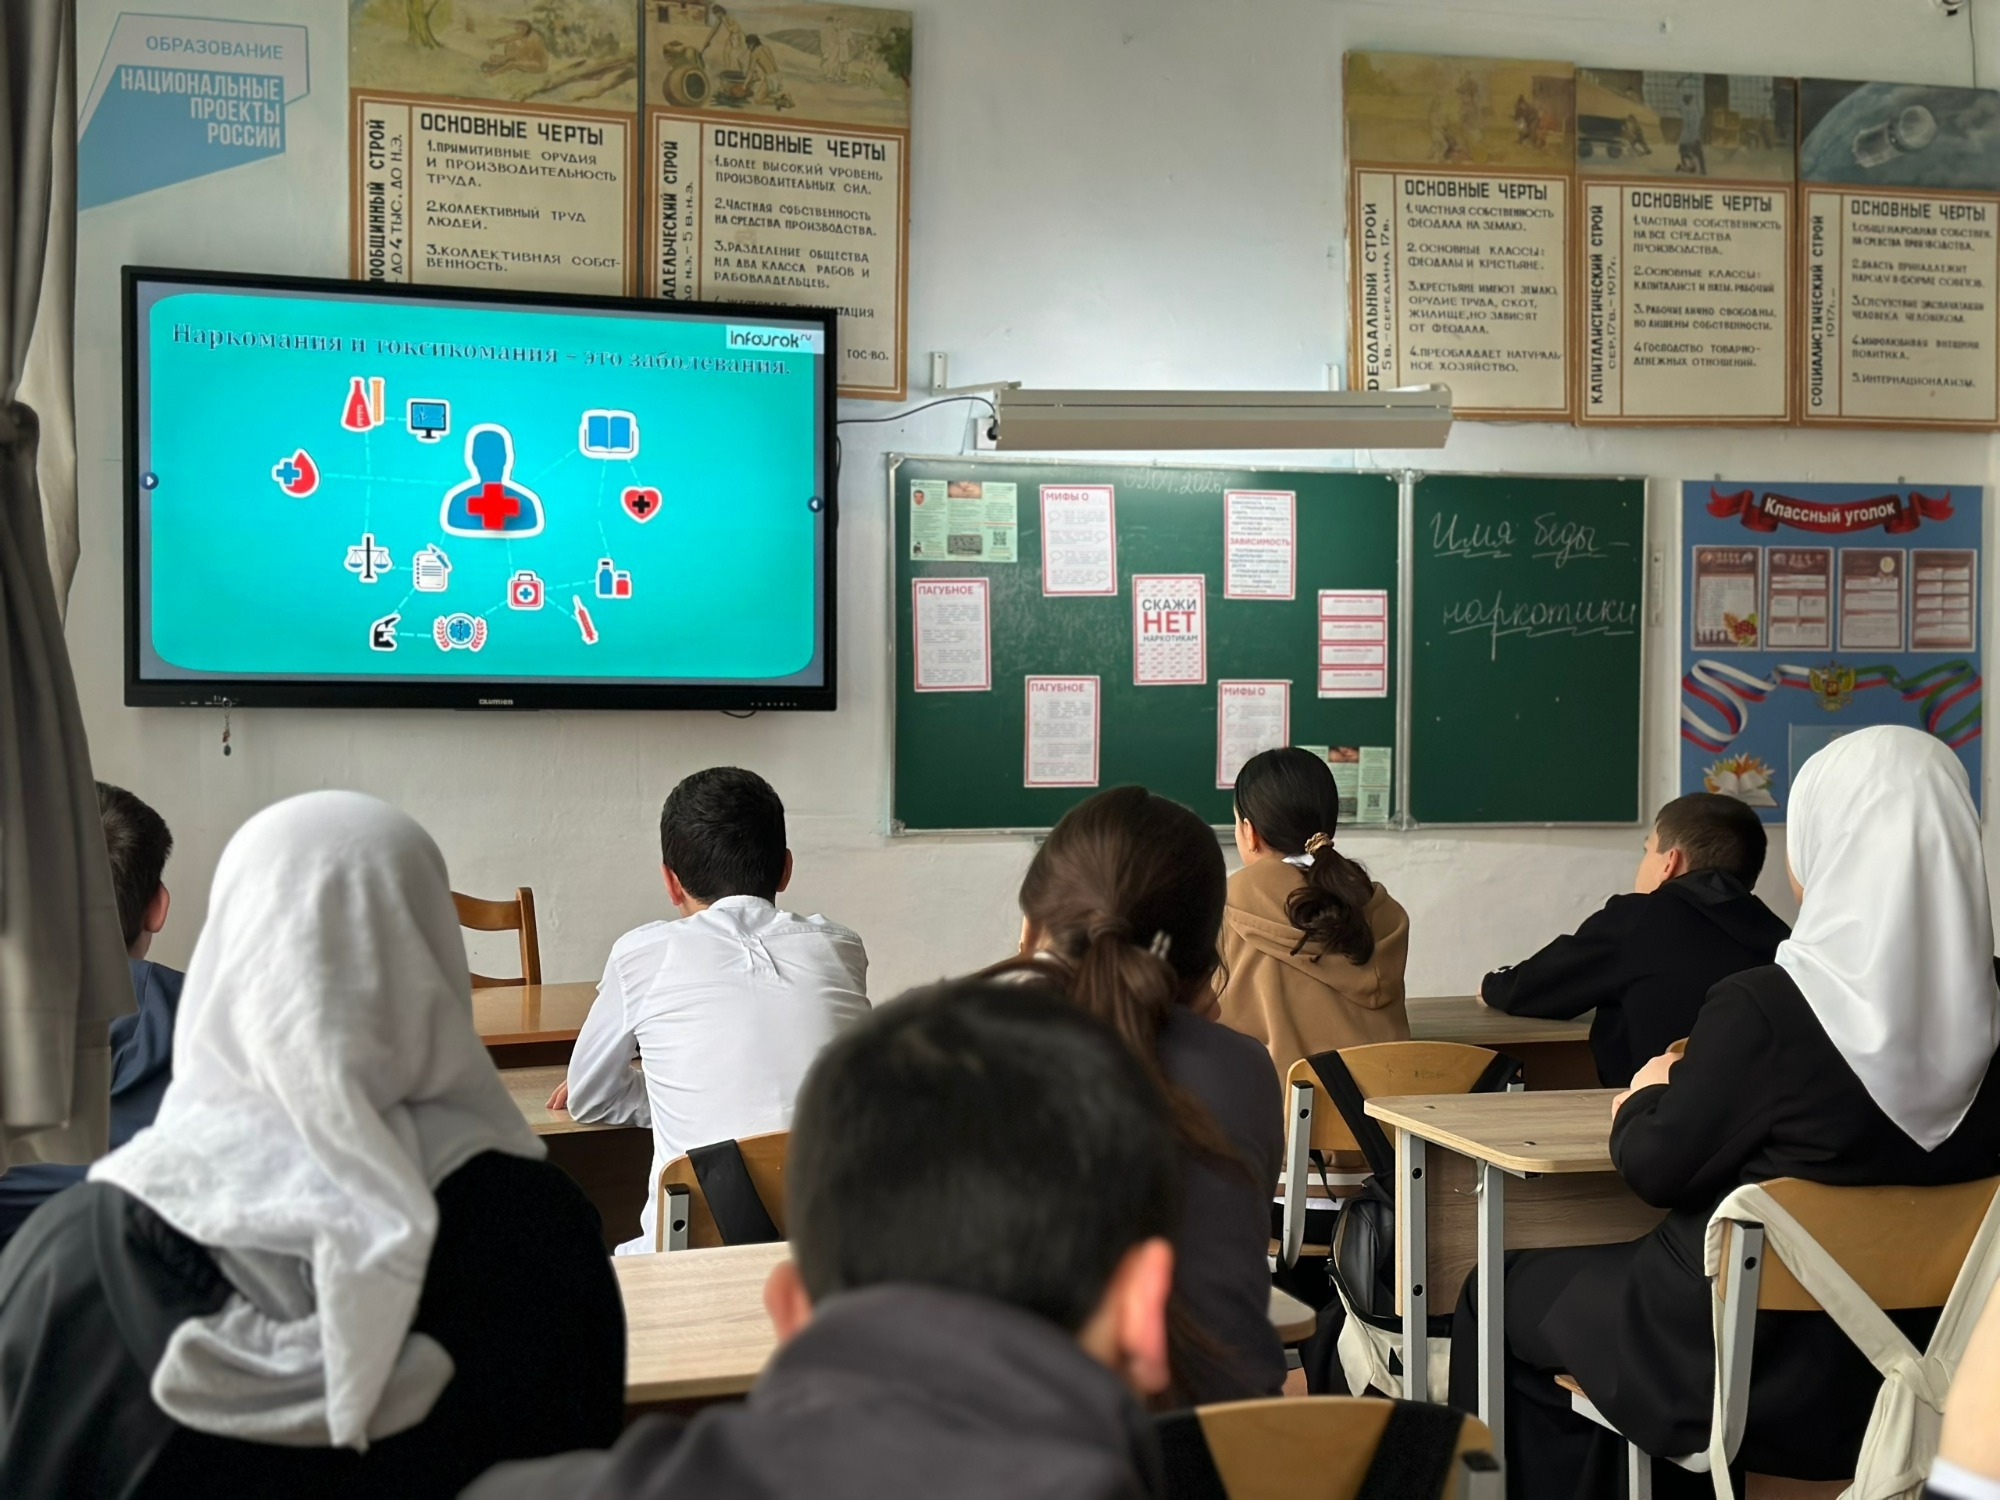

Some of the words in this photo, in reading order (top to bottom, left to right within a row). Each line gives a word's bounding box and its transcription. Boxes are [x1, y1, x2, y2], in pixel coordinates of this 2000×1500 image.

[146, 35, 284, 60] ОБРАЗОВАНИЕ
[121, 68, 280, 100] НАЦИОНАЛЬНЫЕ
[191, 97, 280, 125] ПРОЕКТЫ
[208, 122, 281, 148] РОССИИ
[421, 113, 528, 139] ОСНОВНЫЕ
[538, 122, 604, 146] ЧЕРТЫ
[366, 119, 385, 170] СТРОЙ
[715, 129, 813, 155] ОСНОВНЫЕ
[827, 139, 886, 161] ЧЕРТЫ
[541, 151, 597, 165] ОРУДИЯ
[660, 140, 678, 184] СТРОЙ
[427, 157, 437, 169] И
[446, 158, 617, 182] ПРОИЗВОДИТЕЛЬНОСТЬ
[763, 161, 823, 177] ВЫСОКИЙ
[829, 167, 883, 182] УРОВЕНЬ
[427, 172, 482, 187] ТРУДА.
[716, 172, 836, 192] ПРОИЗВОДИТЕЛЬНЫХ
[843, 182, 871, 195] СИЛ.
[1404, 179, 1490, 199] ОСНОВНЫЕ
[1498, 183, 1547, 201] ЧЕРТЫ
[1631, 191, 1713, 211] ОСНОВНЫЕ
[1723, 194, 1772, 213] ЧЕРТЫ
[551, 210, 586, 223] ТРУД
[779, 205, 871, 222] СОБСТВЕННОСТЬ
[1468, 206, 1555, 219] СОБСТВЕННОСТЬ
[1851, 199, 1931, 219] ОСНОВНЫЕ
[1940, 205, 1985, 222] ЧЕРТЫ
[427, 216, 488, 231] ЛЮДЕЙ.
[715, 214, 728, 225] НА
[730, 215, 781, 230] СРЕДСТВА
[785, 220, 878, 237] ПРОИЗВОДСТВА.
[1407, 217, 1462, 230] ФЕОДАЛА
[1466, 219, 1480, 230] НА
[1483, 220, 1527, 232] ЗЕМЛЮ.
[1590, 205, 1604, 247] СТРОЙ
[1693, 219, 1782, 230] СОБСТВЕННОСТЬ
[1361, 203, 1377, 263] СТРОЙ
[1633, 230, 1646, 240] НА
[1648, 230, 1665, 240] ВСЕ
[1670, 230, 1732, 242] СРЕДСТВА
[1810, 215, 1824, 257] СТРОЙ
[660, 193, 678, 300] АДЕЛЬЧЕСКИЙ
[1489, 246, 1545, 258] КЛАССЫ:
[1633, 243, 1724, 255] ПРОИЗВОДСТВА.
[572, 255, 621, 268] СОБСТ-
[809, 248, 869, 264] ОБЩЕСТВА
[1408, 256, 1463, 269] ФЕОДАЛЫ
[1466, 258, 1475, 269] И
[1479, 259, 1545, 271] КРЕСТЬЯНЕ.
[427, 257, 508, 272] ВЕННОСТЬ.
[715, 256, 729, 267] НА
[735, 258, 757, 269] ДВА
[762, 260, 806, 274] КЛАССА
[816, 263, 856, 278] РАБОВ
[861, 266, 871, 278] И
[715, 271, 829, 289] РАБОВЛАДЕЛЬЦЕВ.
[1634, 281, 1697, 292] КАПИТАЛИСТ
[1699, 283, 1705, 292] И
[1478, 283, 1516, 295] ИМЕЮТ
[1408, 295, 1458, 307] ОРУДИЕ
[1460, 296, 1499, 309] ТРУДА,
[1502, 298, 1538, 310] СКОТ,
[1489, 310, 1538, 322] ЗАВИСЯТ
[1852, 310, 1900, 321] ЧЕЛОВЕКА
[1408, 323, 1425, 334] ОТ
[1431, 323, 1490, 336] ФЕОДАЛА.
[1590, 253, 1604, 404] КАПИТАЛИСТИЧЕСКИЙ
[1634, 319, 1646, 329] НО
[1648, 320, 1690, 330] ЛИШЕНЫ
[1811, 264, 1824, 407] СОЦИАЛИСТИЧЕСКИЙ
[172, 323, 343, 351] Наркомания
[350, 336, 366, 352] и
[377, 339, 558, 363] токсикомания
[585, 347, 623, 368] это
[629, 351, 791, 376] заболевания.
[1410, 361, 1434, 372] НОЕ
[1439, 361, 1519, 374] ХОЗЯЙСТВО.
[1633, 356, 1688, 367] ДЕНЕЖНЫХ
[1046, 492, 1079, 501] МИФЫ
[1763, 496, 1841, 524] Классный
[1846, 502, 1897, 527] уголок
[1430, 512, 1517, 550] Имя
[1533, 512, 1601, 570] беды
[918, 585, 974, 595] ПАГУБНОЕ
[1142, 598, 1197, 611] СКАЖИ
[1143, 611, 1196, 633] НЕТ
[1443, 590, 1636, 661] наркотики
[1143, 634, 1198, 643] НАРКОТИКАМ
[1031, 683, 1085, 692] ПАГУБНОЕ
[1224, 687, 1255, 696] МИФЫ
